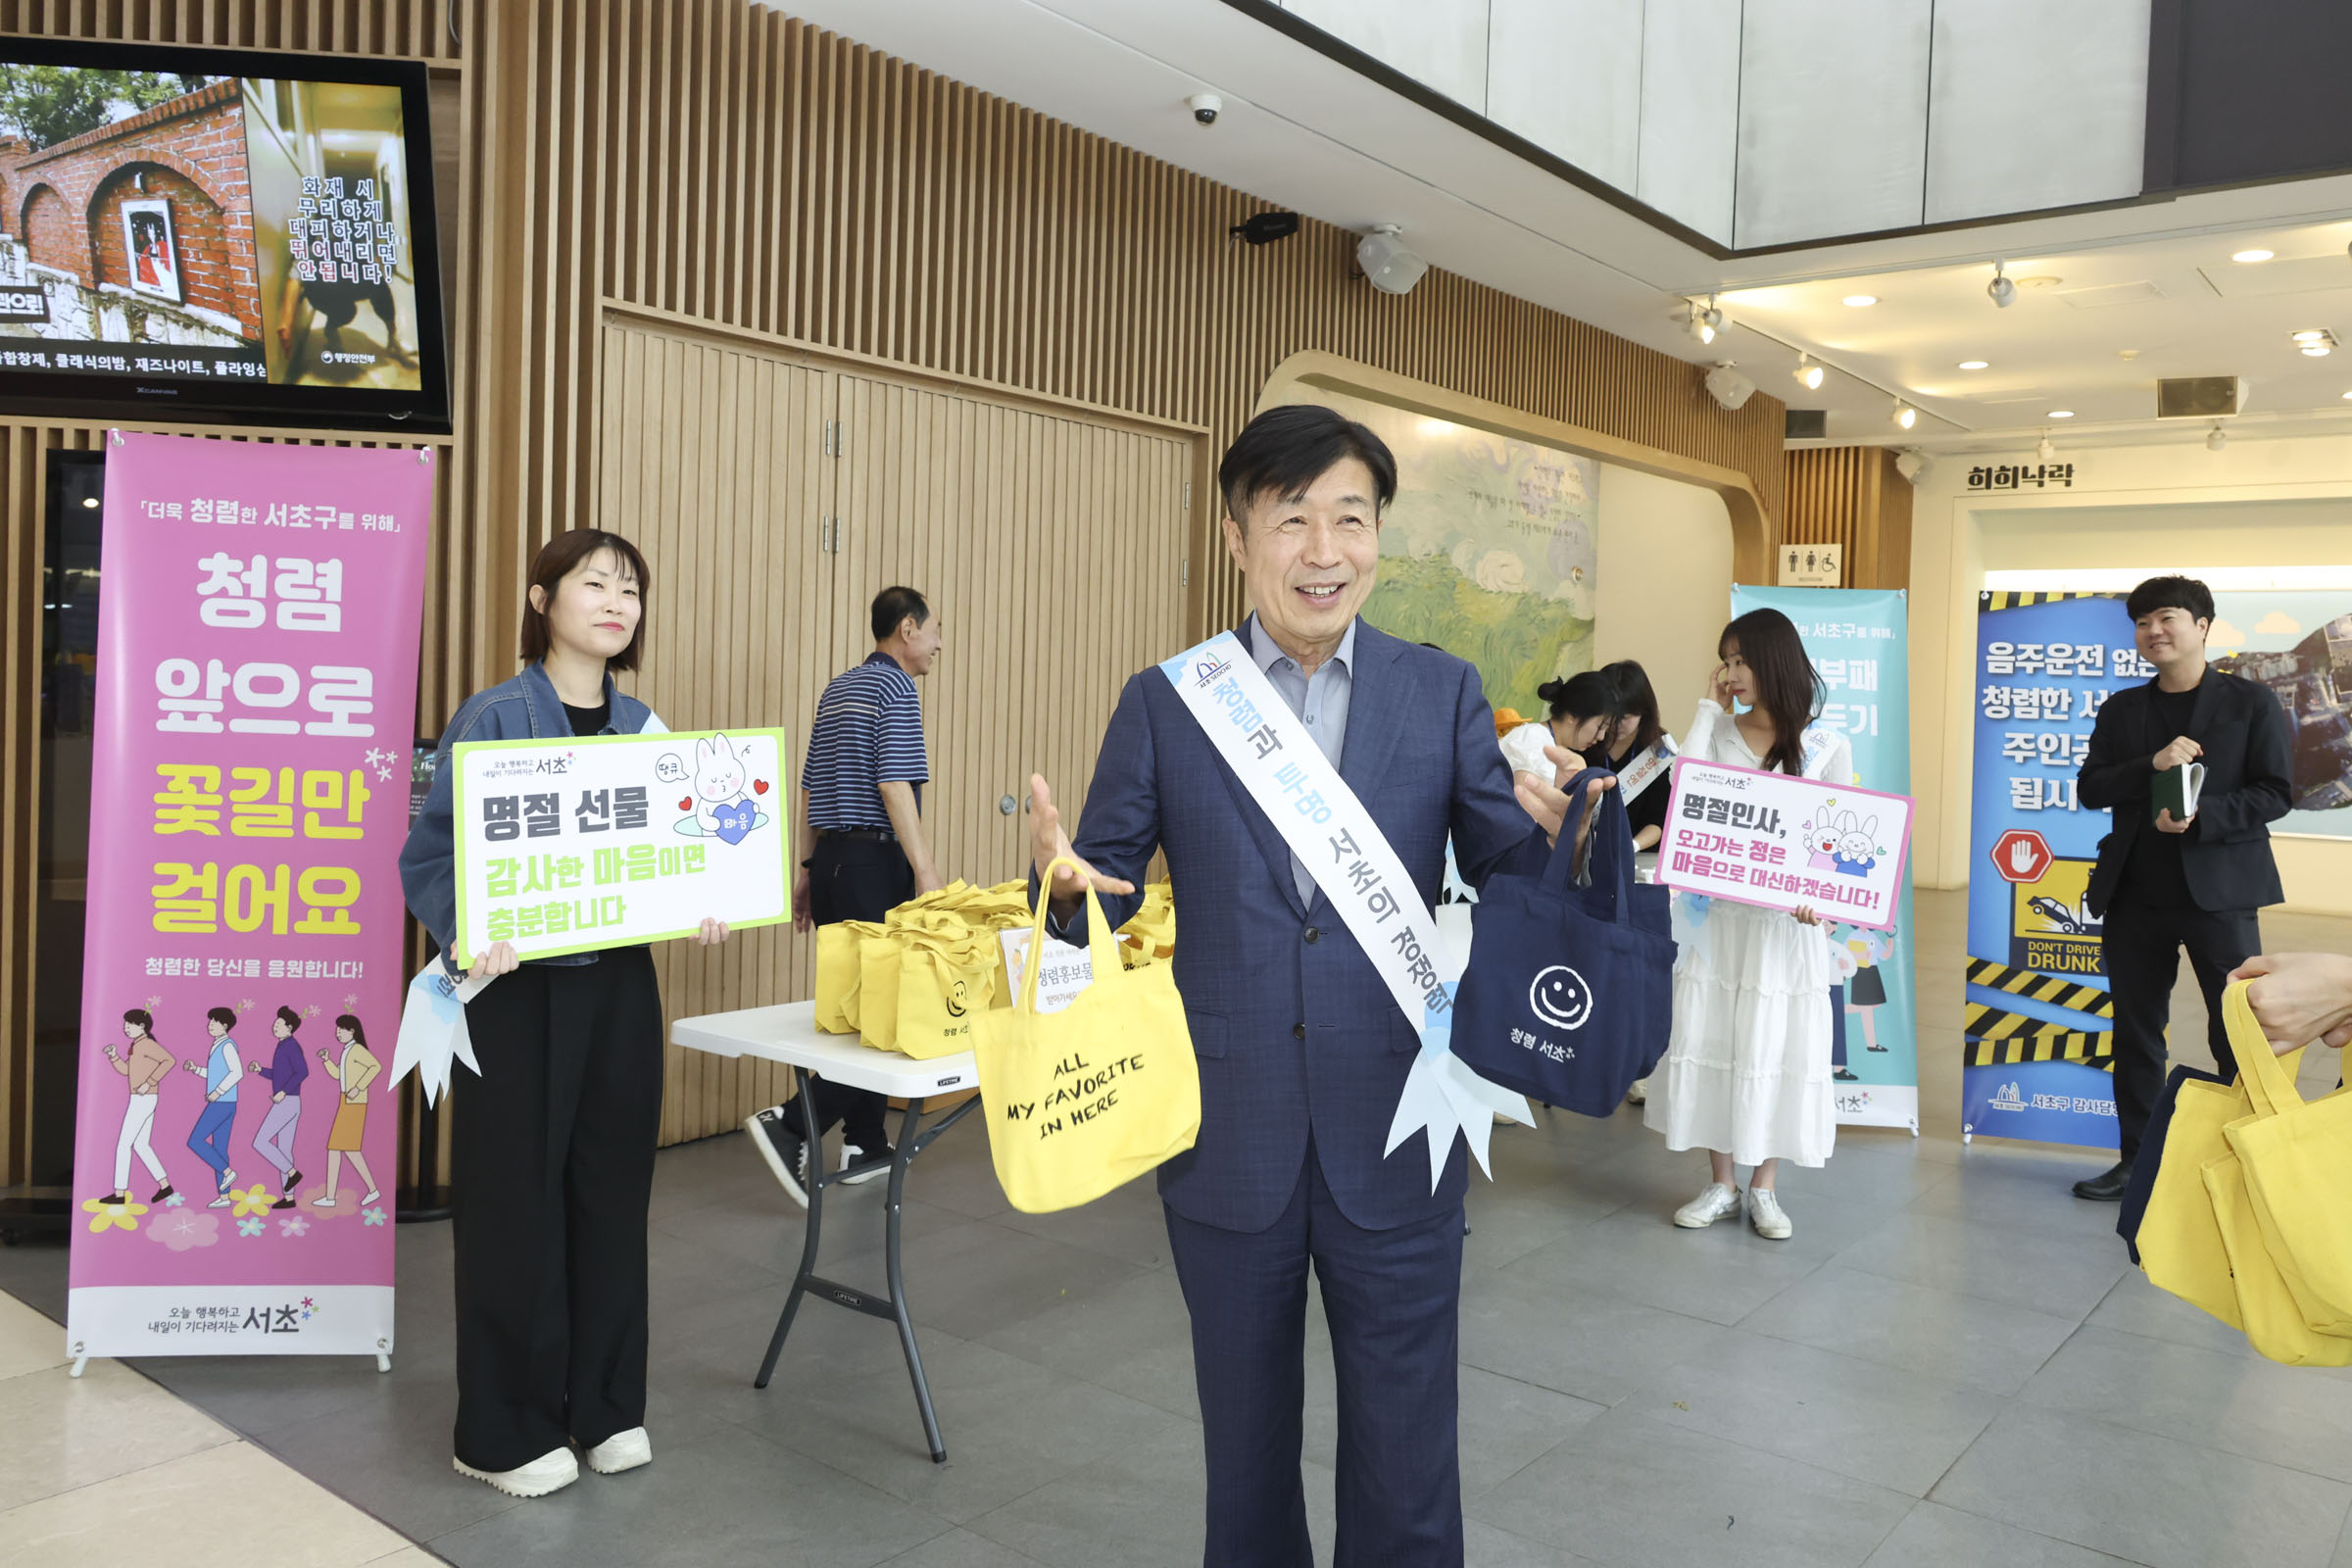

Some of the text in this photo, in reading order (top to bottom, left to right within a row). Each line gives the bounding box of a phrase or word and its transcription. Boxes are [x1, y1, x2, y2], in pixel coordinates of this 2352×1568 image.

[302, 176, 373, 200] 화재 시
[298, 198, 382, 221] 무리하게
[288, 218, 394, 243] 대피하거나
[289, 239, 397, 265] 뛰어내리면
[297, 260, 393, 284] 안됩니다!
[0, 351, 51, 368] 합창제,
[55, 353, 130, 371] 클래식의밤,
[134, 358, 210, 376] 재즈나이트,
[334, 352, 375, 364] 행정안전부
[190, 498, 258, 525] 청렴한
[264, 503, 354, 530] 서초구를
[196, 552, 343, 632] 청렴
[1210, 663, 1232, 681] SEOCHO
[1810, 658, 1879, 691] 부패
[1985, 641, 2105, 677] 음주운전
[155, 658, 375, 738] 앞으로
[1982, 685, 2073, 720] 청렴한
[536, 757, 567, 774] 서초
[1725, 777, 1746, 790] 서초
[2009, 777, 2112, 813] 됩시
[153, 763, 371, 840] 꽃길만
[482, 792, 561, 842] 명절
[574, 786, 649, 833] 선물
[1682, 793, 1788, 839] 명절인사,
[723, 812, 749, 830] 마음
[1211, 676, 1454, 1014] 청렴과 투명 서초의 경쟁력
[1676, 829, 1787, 866] 오고가는 정은
[486, 844, 706, 898] 감사한 마음이면
[1671, 851, 1881, 909] 마음으로 대신하겠습니다!
[151, 861, 362, 935] 걸어요
[487, 895, 627, 942] 충분합니다
[2028, 941, 2101, 956] DON'T DRIVE
[2028, 952, 2101, 973] DRUNK
[145, 956, 364, 979] 청렴한 당신을 응원합니다!
[1510, 1027, 1564, 1063] 청렴 서초
[1054, 1053, 1090, 1082] ALL
[1007, 1054, 1145, 1120] MY FAVORITE
[2031, 1093, 2071, 1111] 서초구
[1040, 1089, 1119, 1141] IN HERE
[148, 1321, 239, 1334] 내일이 기다려지는
[169, 1306, 241, 1319] 오늘 행복하고
[242, 1303, 299, 1334] 서초
